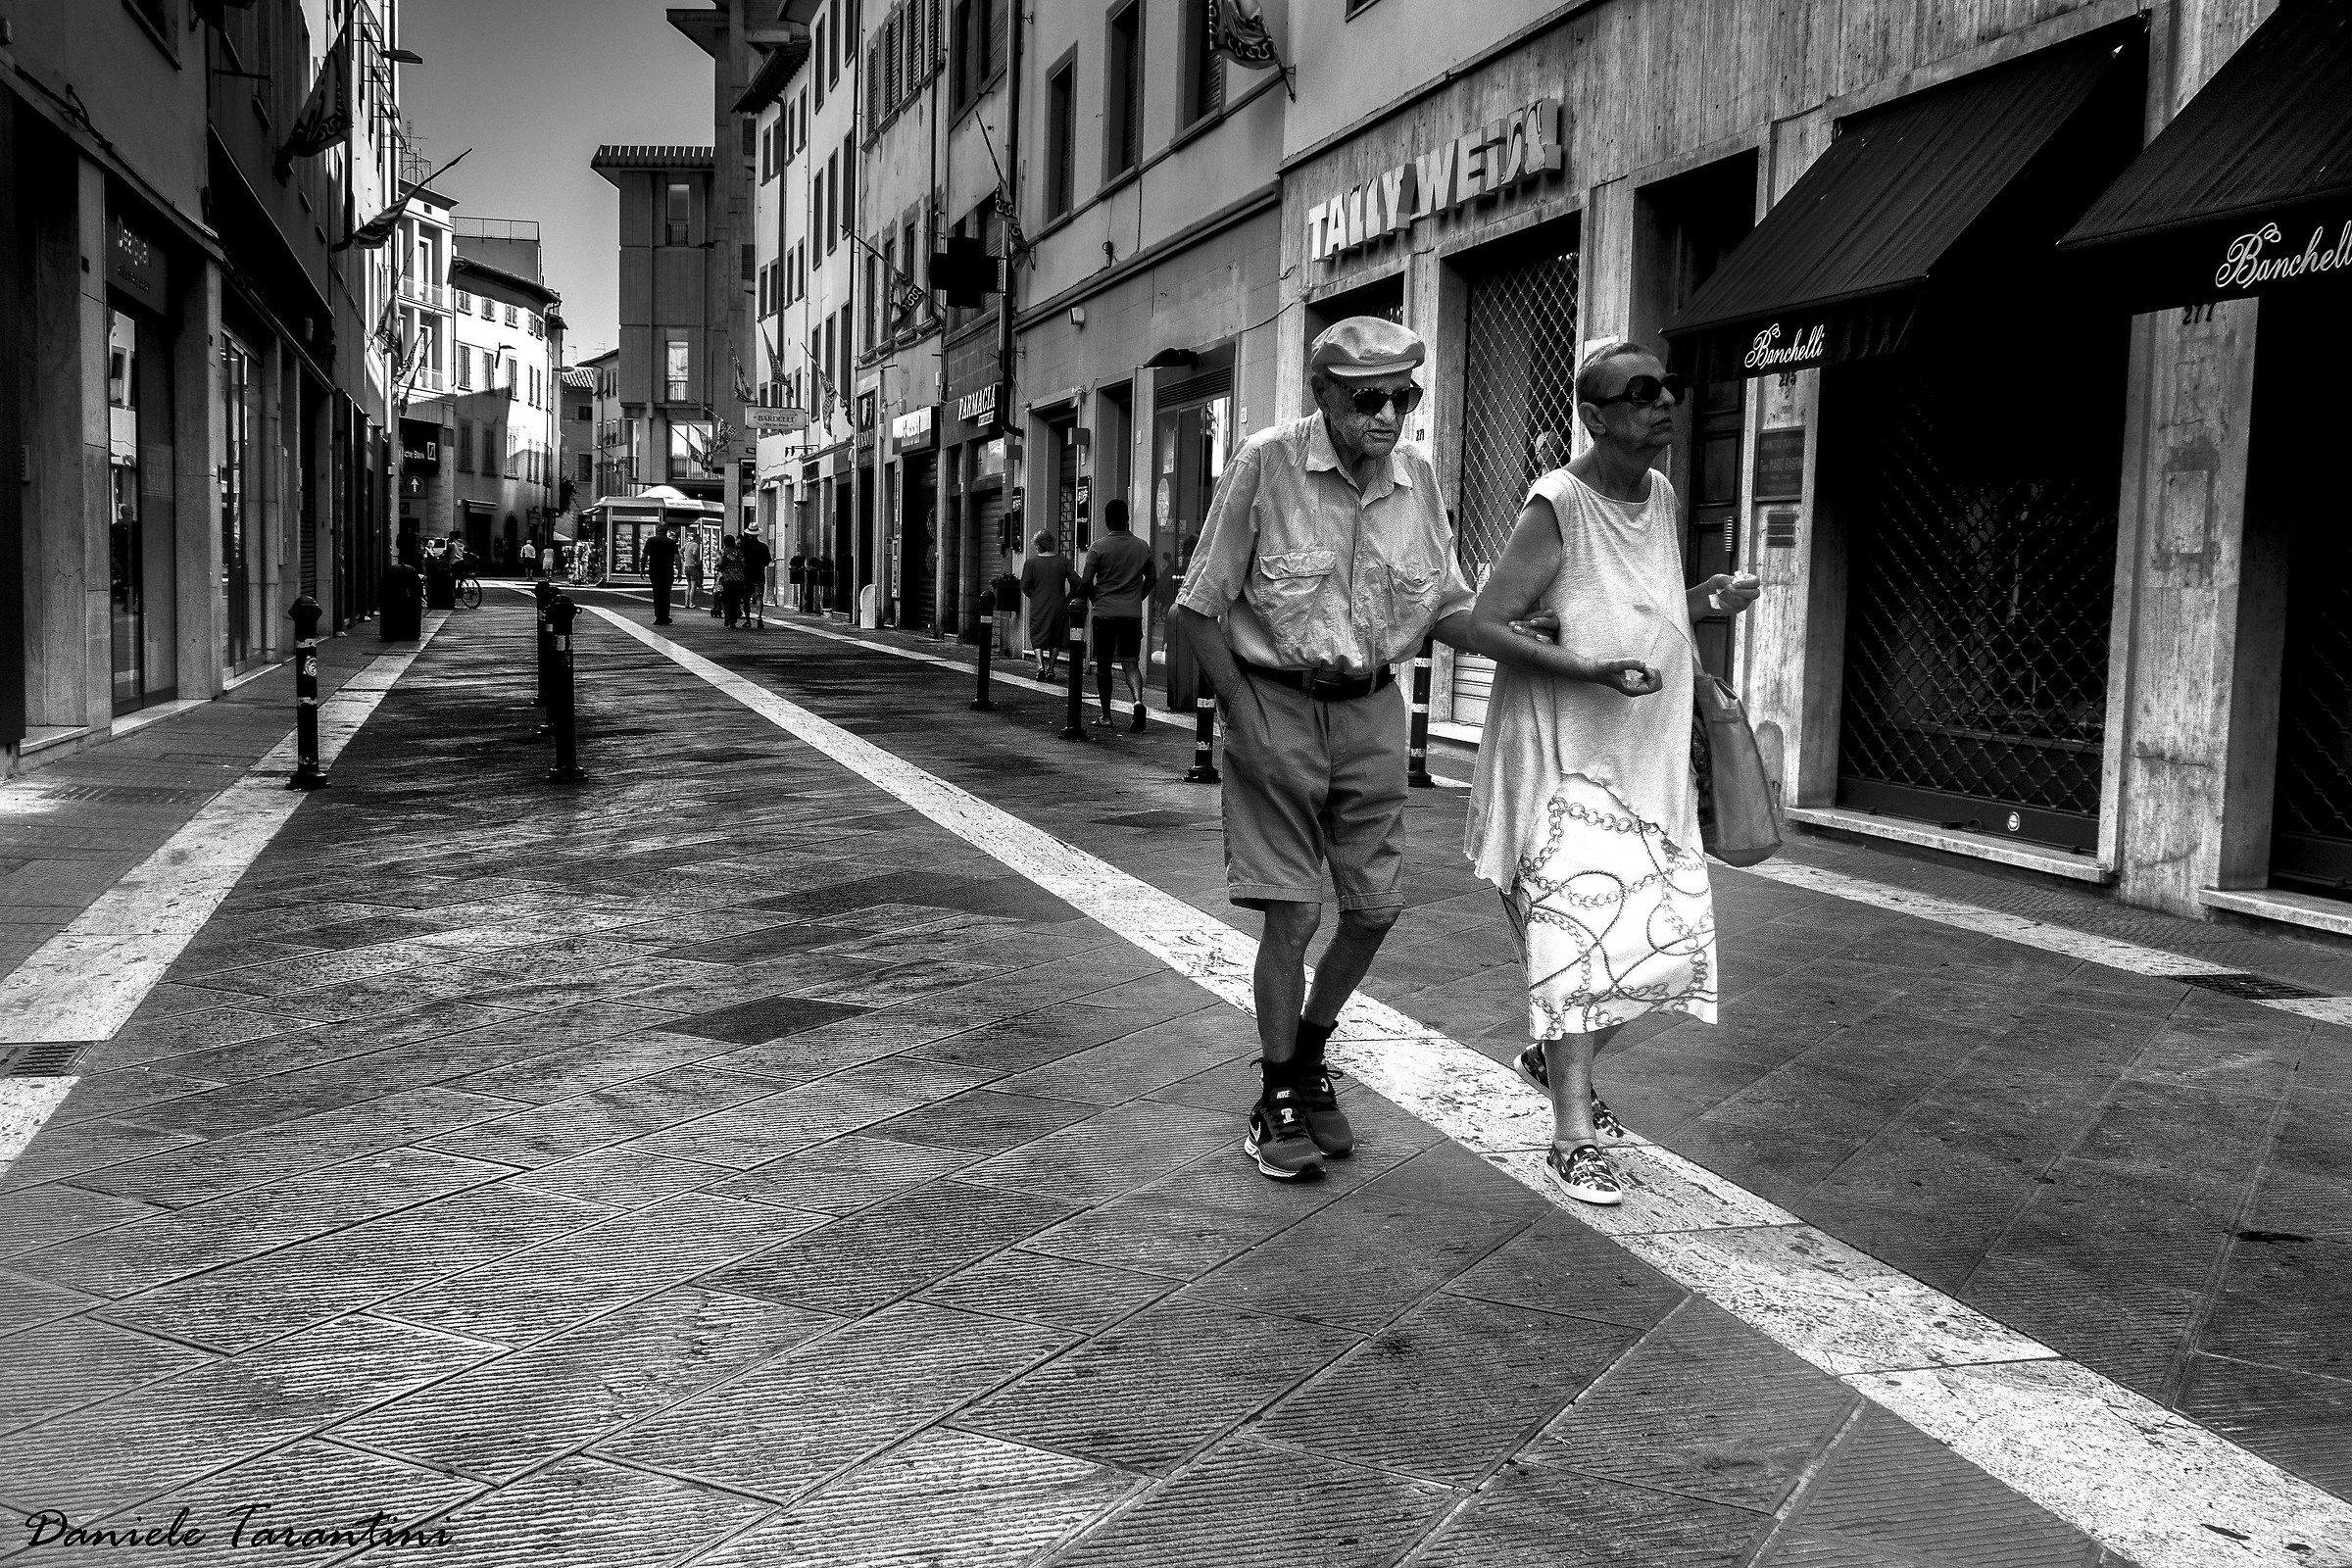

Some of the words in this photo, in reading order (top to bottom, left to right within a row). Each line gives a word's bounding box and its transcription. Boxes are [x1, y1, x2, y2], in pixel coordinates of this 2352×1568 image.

[1308, 164, 1414, 262] TALLY
[1744, 322, 1825, 369] Banchelli
[958, 383, 995, 421] FARMACIA
